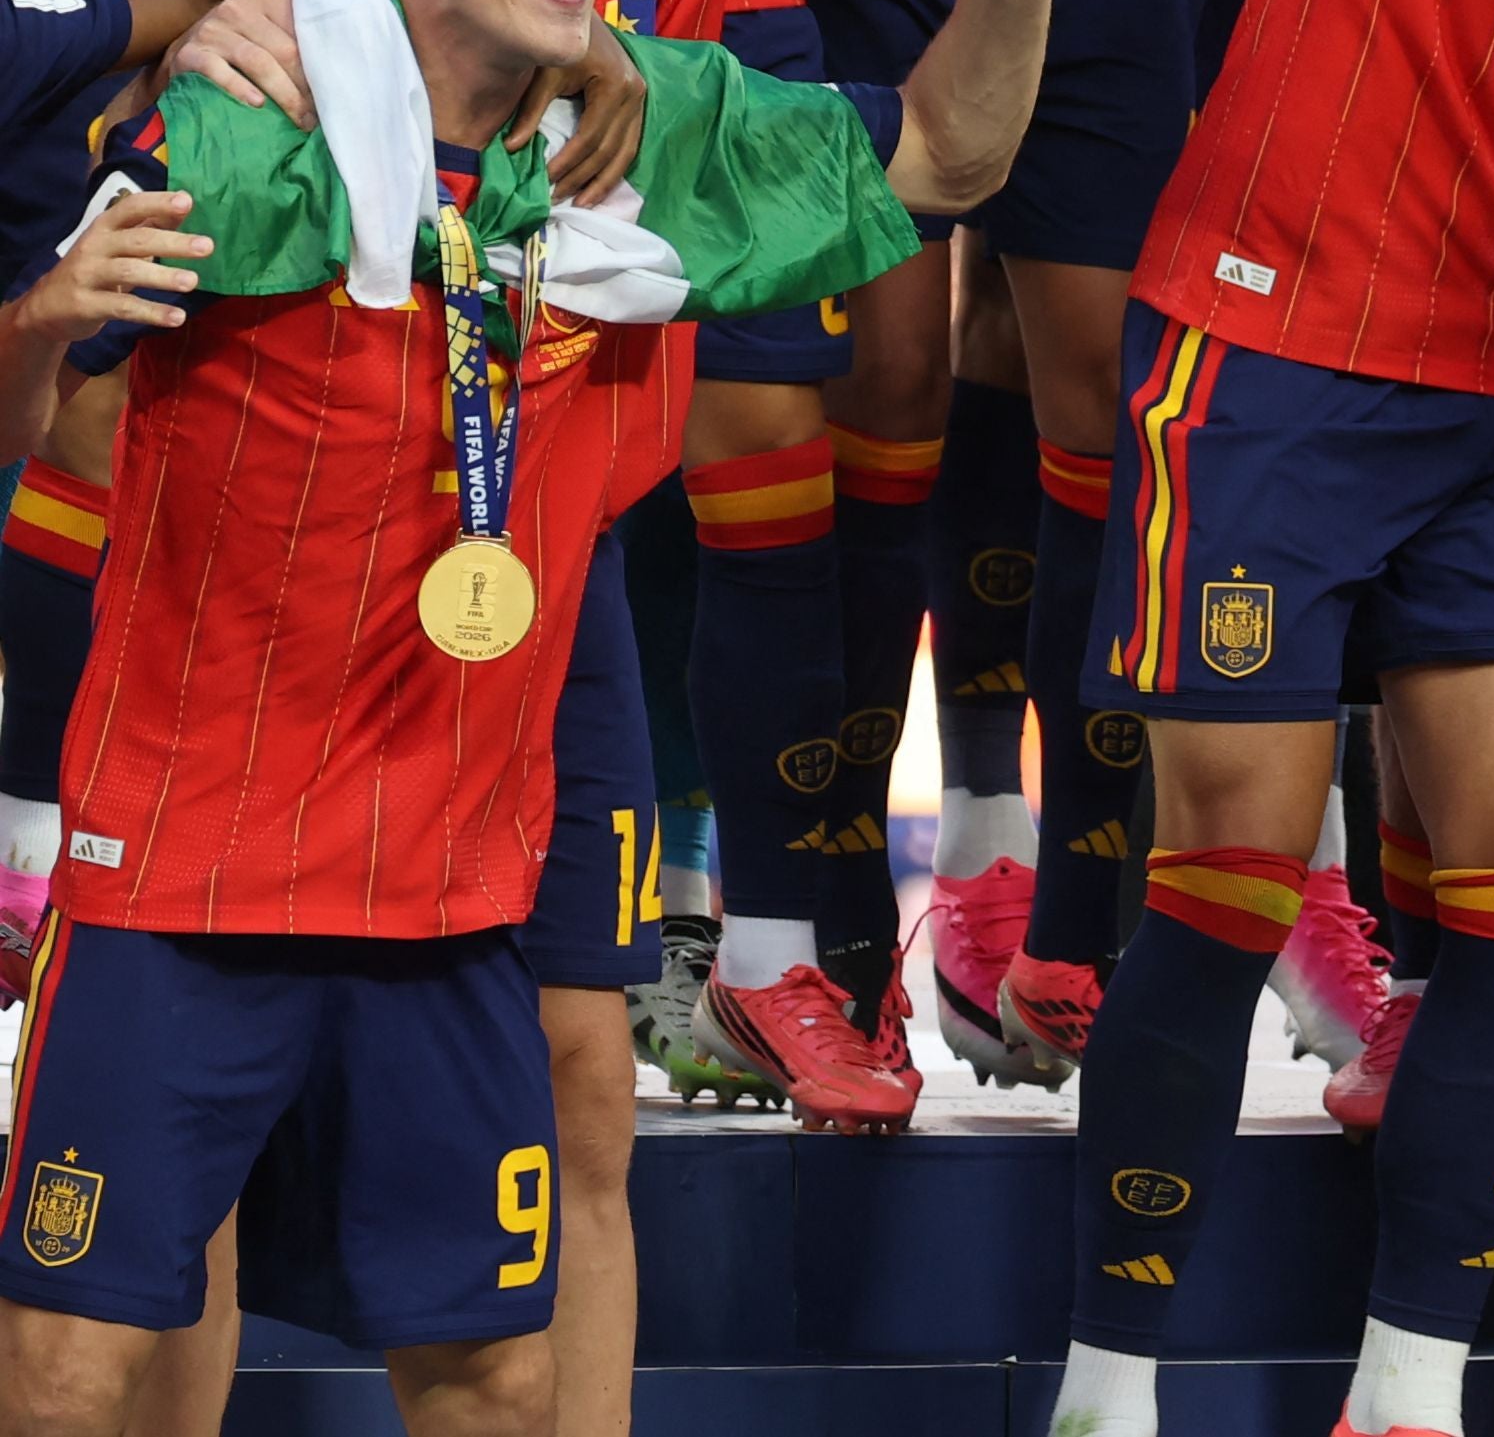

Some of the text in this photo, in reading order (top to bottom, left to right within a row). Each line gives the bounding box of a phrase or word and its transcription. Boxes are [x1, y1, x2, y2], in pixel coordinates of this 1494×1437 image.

[464, 415, 483, 464] FIFA
[455, 631, 492, 642] 2026
[497, 1144, 551, 1290] 9
